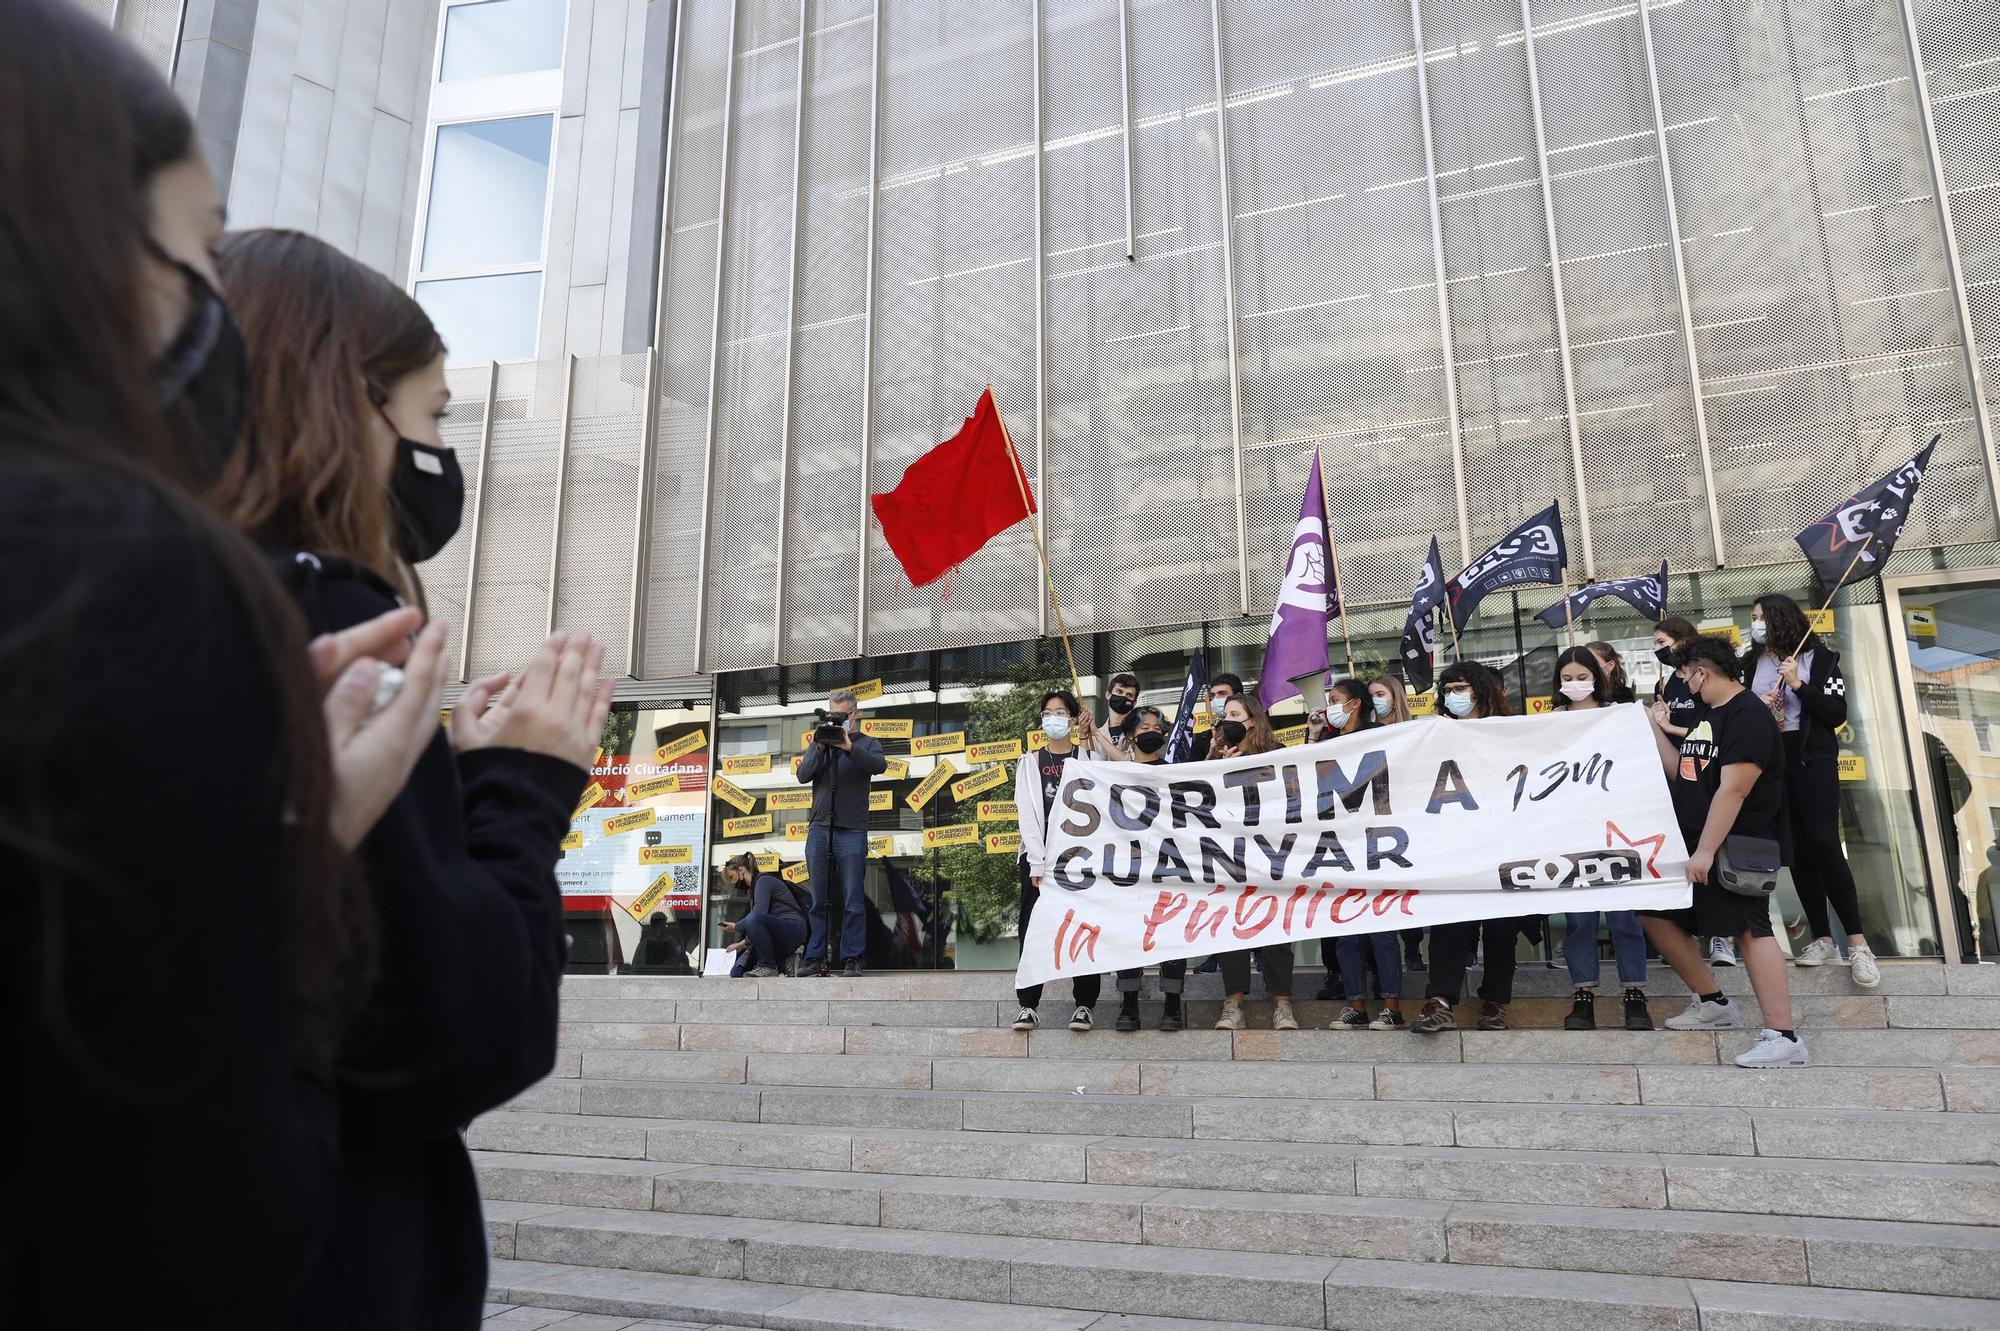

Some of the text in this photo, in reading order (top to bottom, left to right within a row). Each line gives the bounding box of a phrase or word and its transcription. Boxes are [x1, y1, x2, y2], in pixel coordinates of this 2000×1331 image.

[589, 763, 703, 776] tenció Ciutadana
[1060, 750, 1392, 837] SORTIM
[1425, 759, 1480, 814] A
[1053, 826, 1414, 892] GUANYAR
[1053, 908, 1101, 971] la
